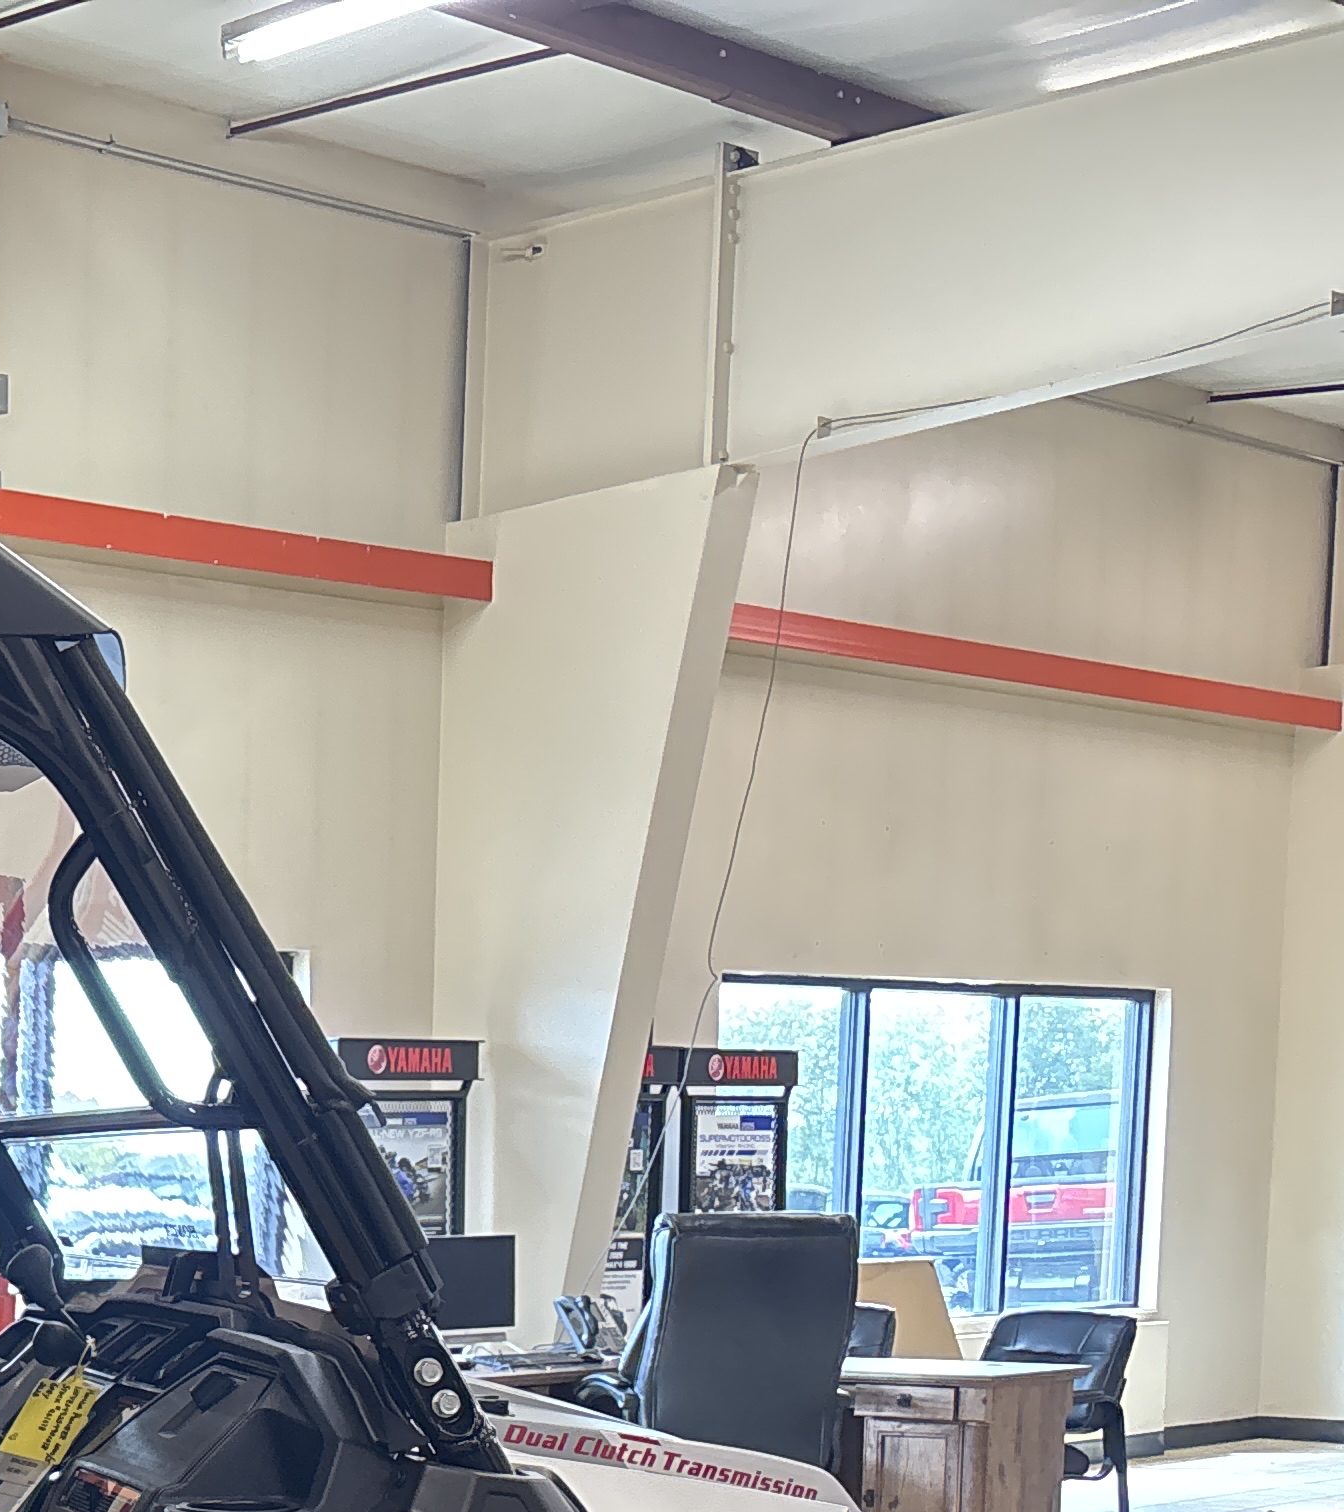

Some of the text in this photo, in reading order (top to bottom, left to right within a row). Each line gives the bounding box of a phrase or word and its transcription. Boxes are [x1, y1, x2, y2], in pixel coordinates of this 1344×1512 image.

[388, 1047, 453, 1073] YAMAHA
[725, 1056, 778, 1080] YAMAHA
[503, 1424, 819, 1500] Dual Clutch Transmission
